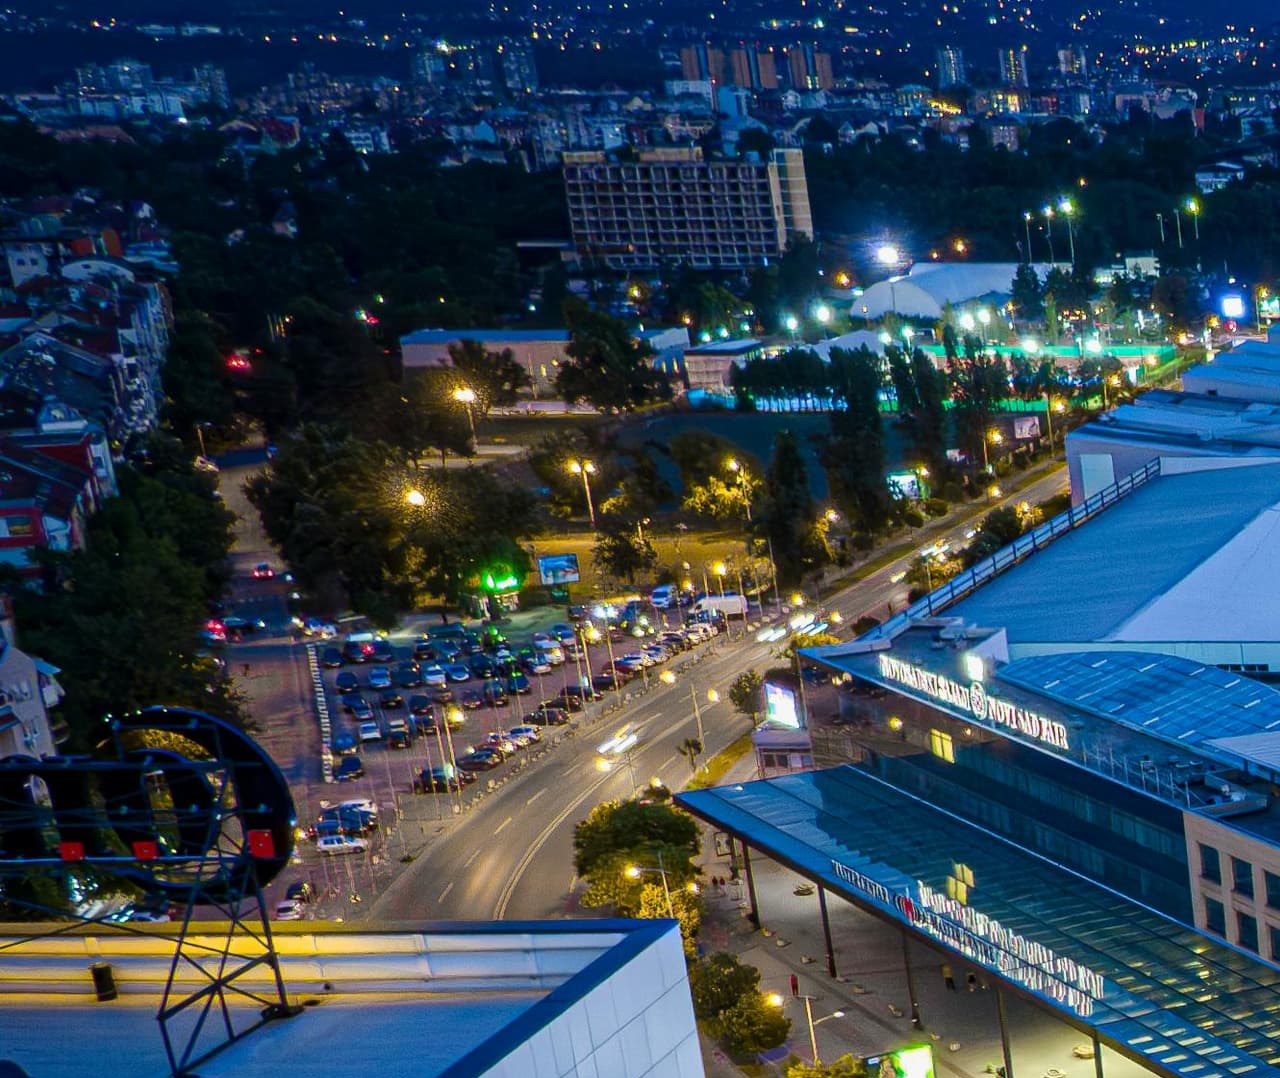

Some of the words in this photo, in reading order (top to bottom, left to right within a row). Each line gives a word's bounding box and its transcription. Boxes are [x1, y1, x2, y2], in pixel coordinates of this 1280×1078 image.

[986, 696, 1017, 729] NOVI
[1017, 708, 1040, 738] SAD
[1039, 716, 1069, 750] FAIR
